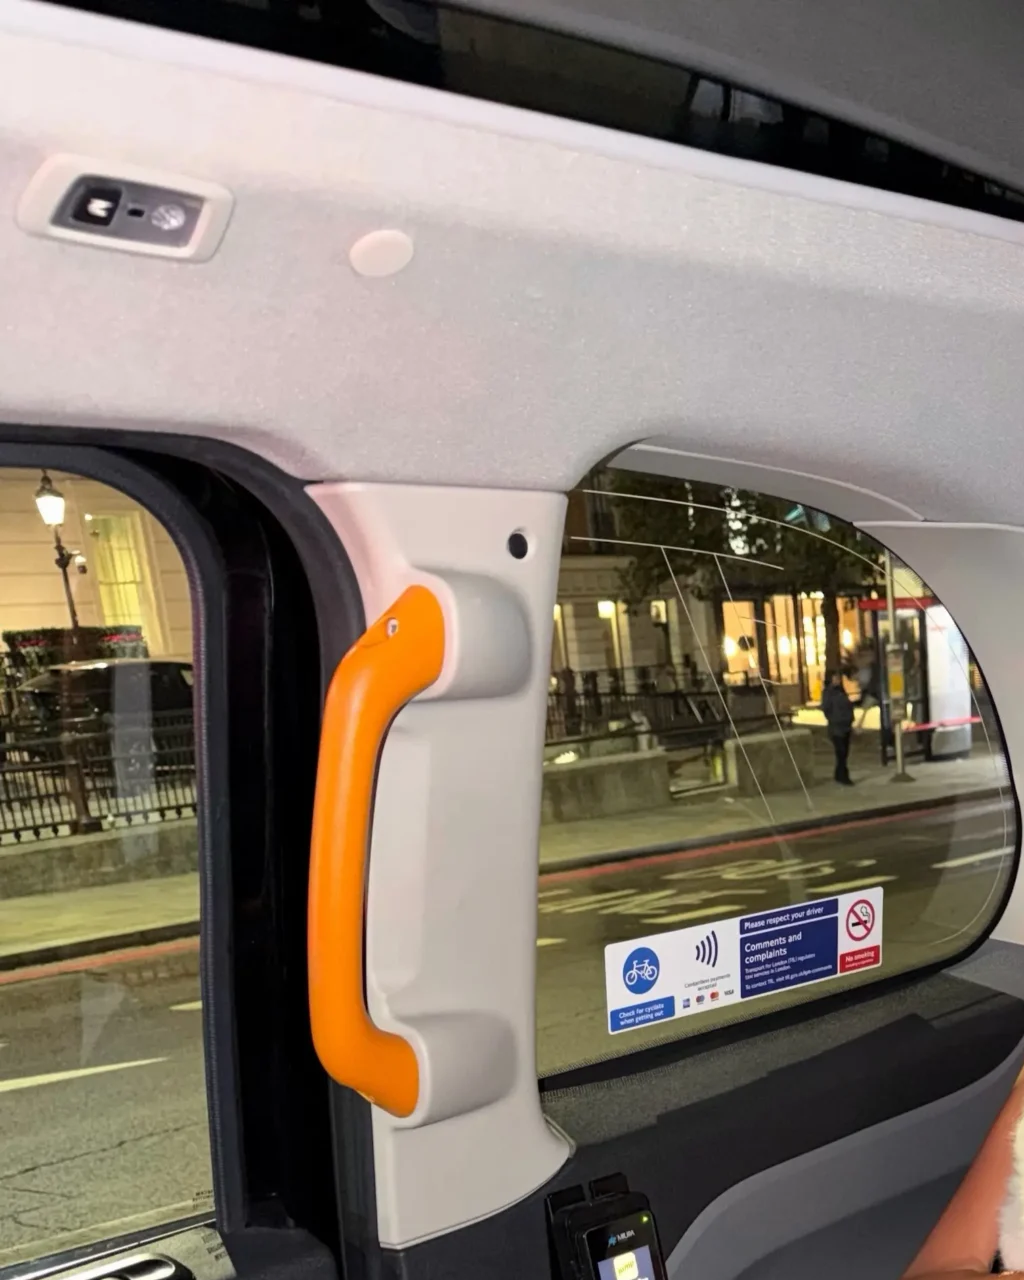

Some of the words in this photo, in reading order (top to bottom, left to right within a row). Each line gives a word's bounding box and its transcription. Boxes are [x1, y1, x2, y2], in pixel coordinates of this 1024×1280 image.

[744, 920, 765, 930] Please
[766, 914, 790, 926] respect
[791, 912, 806, 922] your
[806, 906, 824, 916] driver
[744, 935, 787, 952] Comments
[788, 931, 802, 943] and
[744, 947, 787, 964] complaints
[619, 1010, 635, 1019] Check
[636, 1007, 644, 1015] for
[645, 1003, 664, 1014] cyclists
[620, 1018, 634, 1026] when
[635, 1013, 654, 1023] getting
